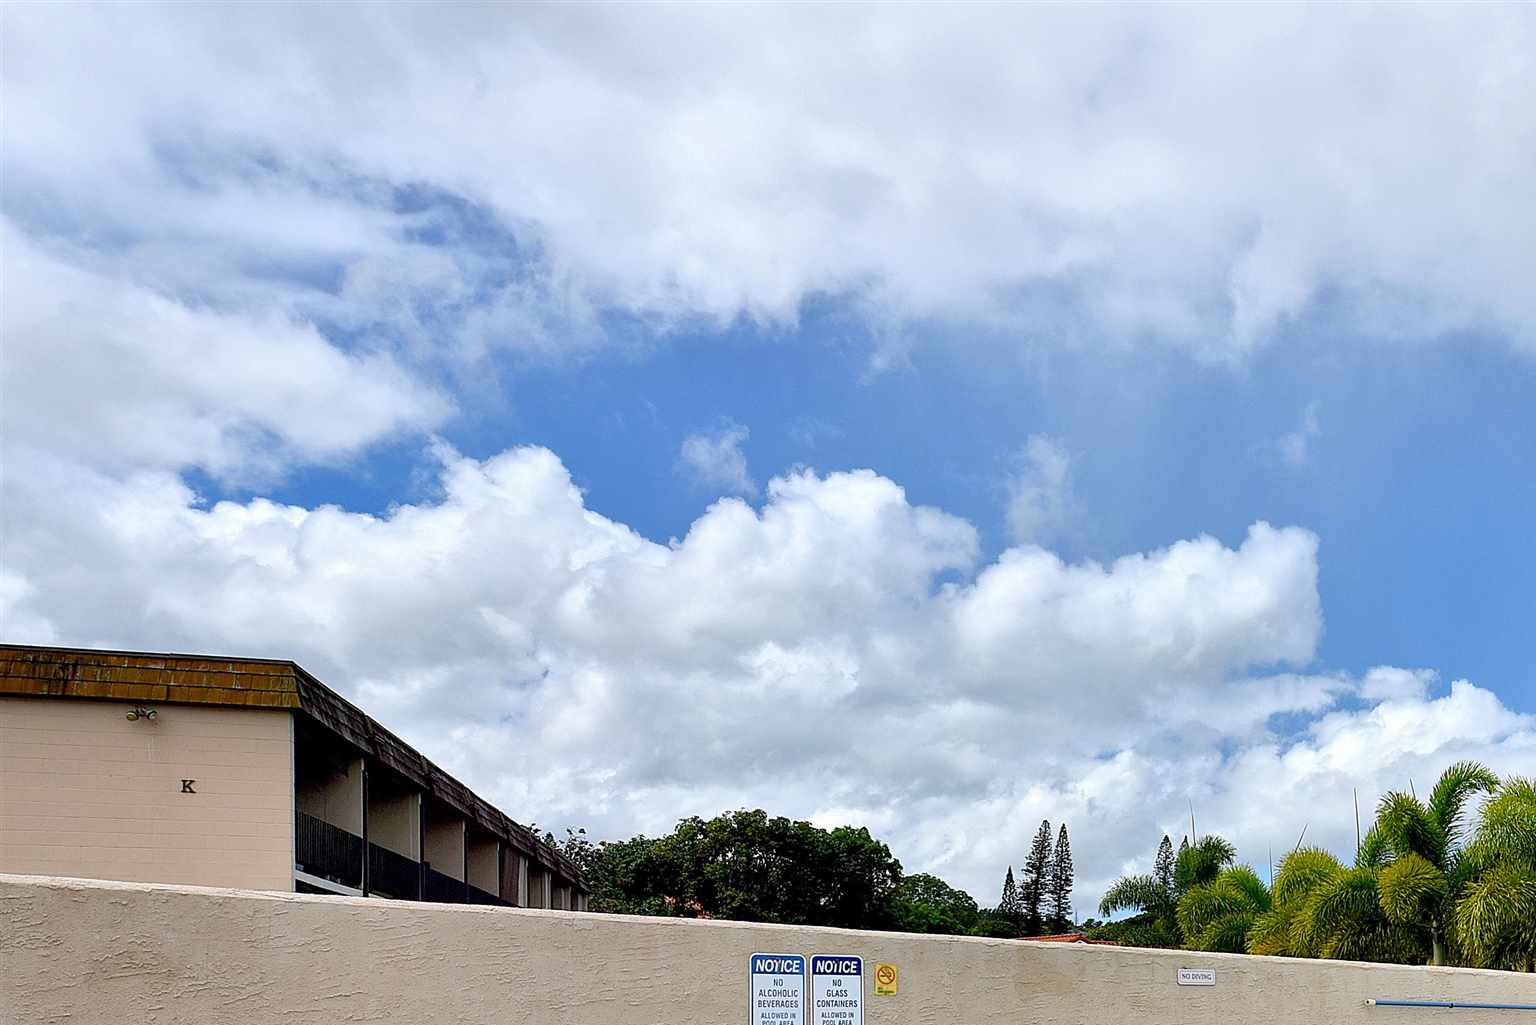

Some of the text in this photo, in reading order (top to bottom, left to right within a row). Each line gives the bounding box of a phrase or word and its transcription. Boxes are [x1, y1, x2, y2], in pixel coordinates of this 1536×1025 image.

[181, 779, 197, 793] K
[755, 959, 801, 973] NOTICE
[815, 960, 858, 973] NOTICE
[773, 978, 784, 987] NO
[832, 979, 842, 987] NO
[758, 989, 799, 998] ALCOHOLIC
[826, 989, 848, 998] GLASS
[757, 999, 799, 1008] BEVERAGES
[816, 1000, 858, 1008] CONTAINERS
